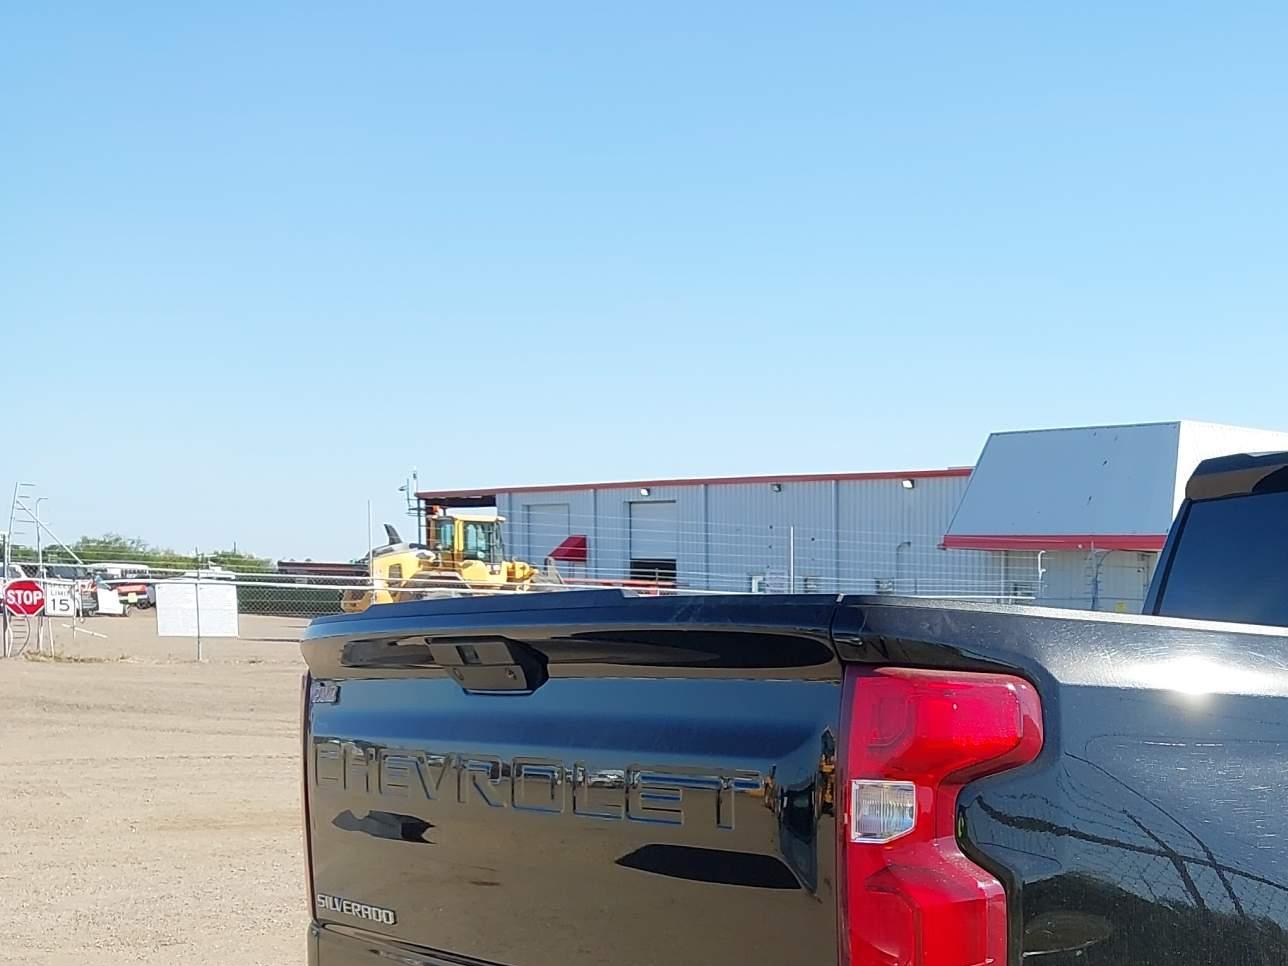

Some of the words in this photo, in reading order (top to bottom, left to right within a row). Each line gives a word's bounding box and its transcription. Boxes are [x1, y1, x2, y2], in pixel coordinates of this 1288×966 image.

[7, 590, 42, 605] STOP
[51, 598, 70, 611] 15
[314, 741, 763, 831] CHEVROLET
[317, 893, 396, 925] SILVERADO
